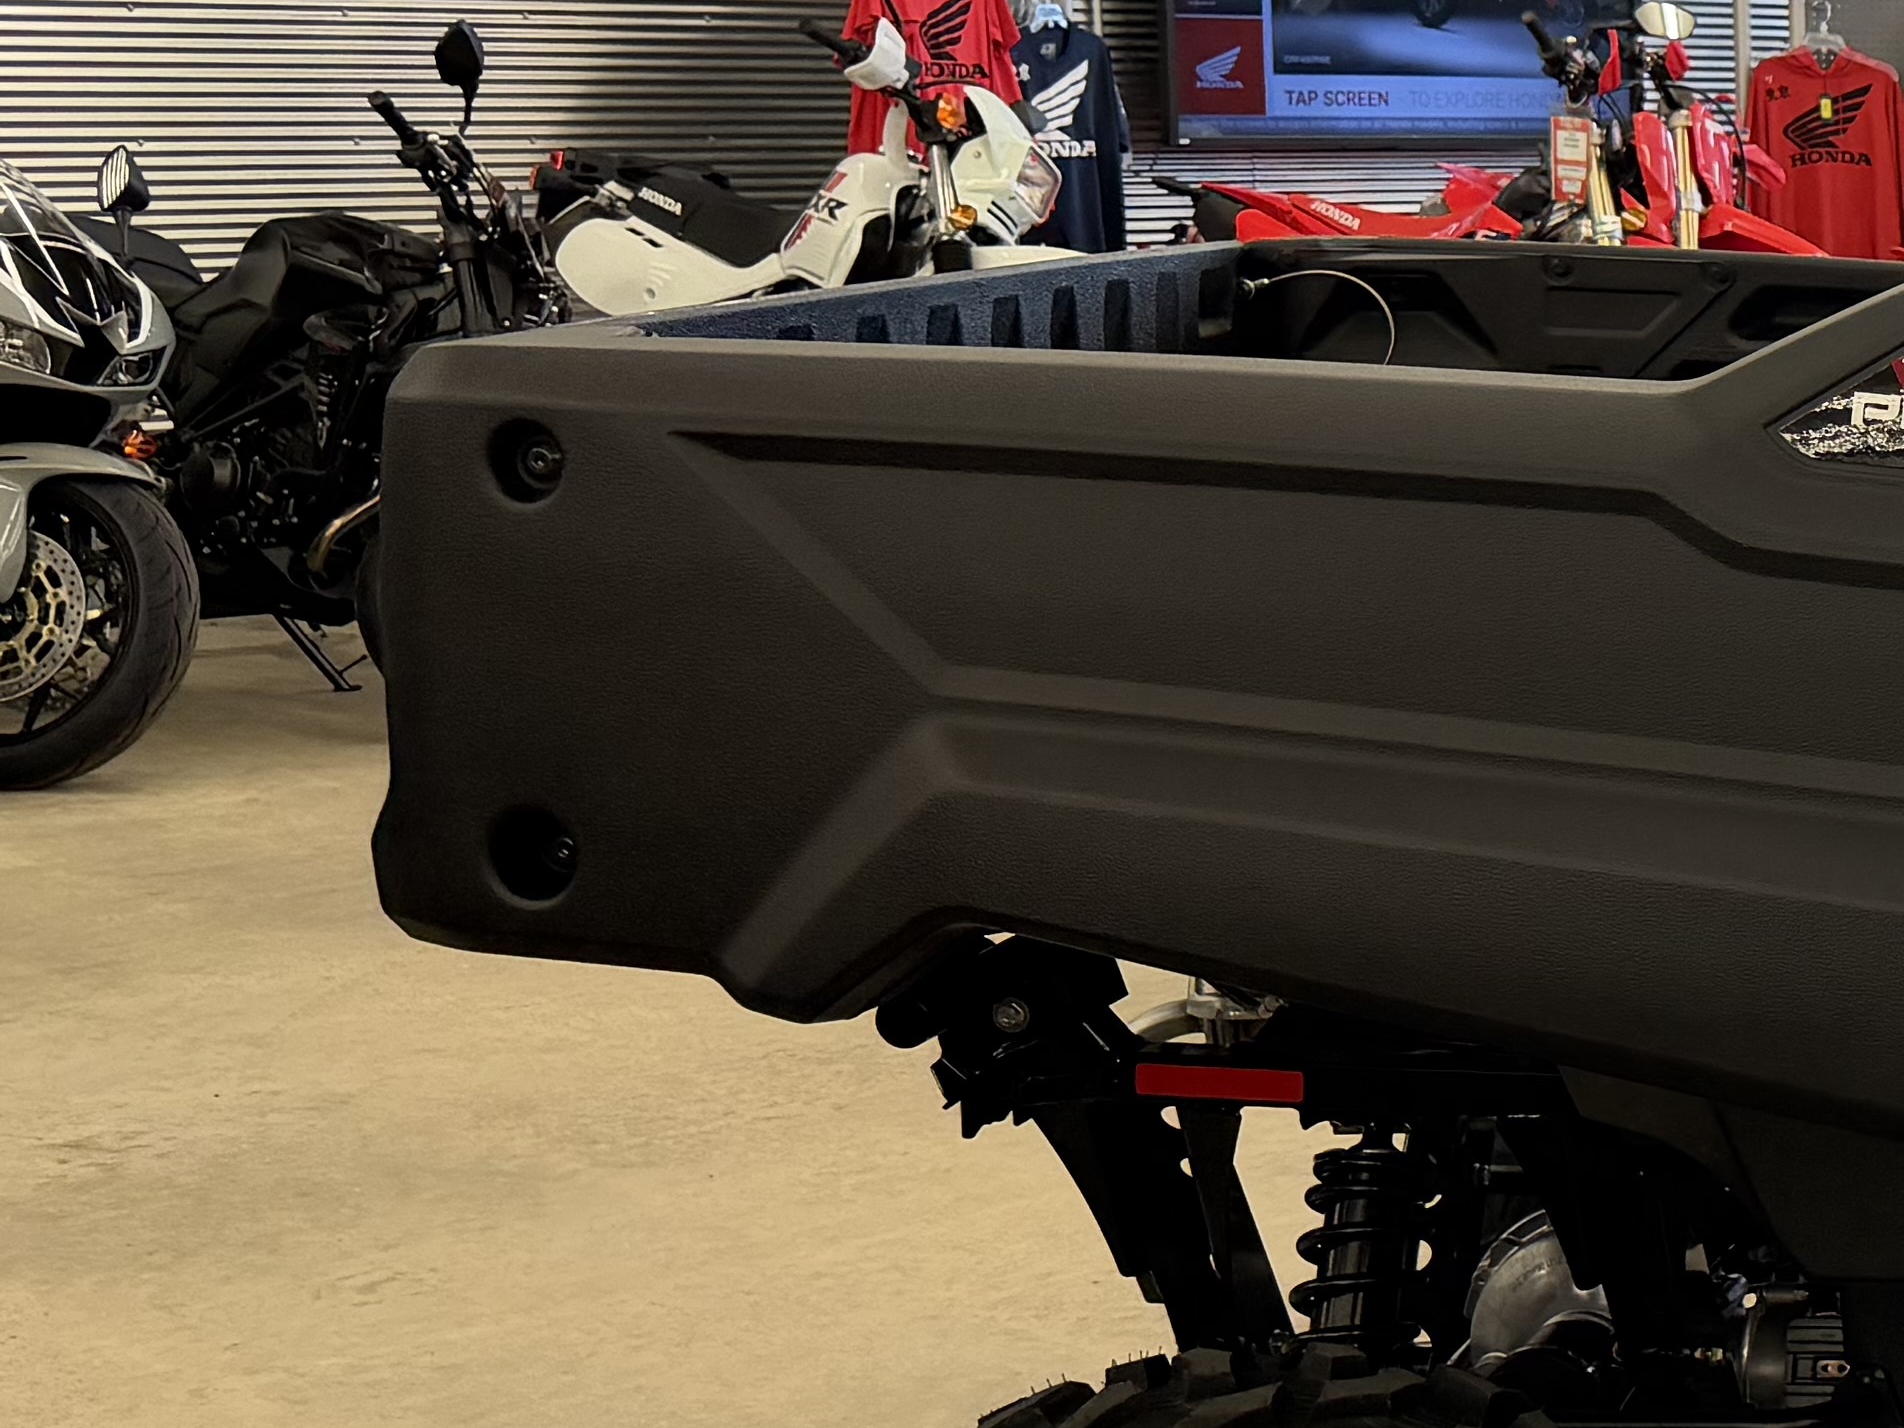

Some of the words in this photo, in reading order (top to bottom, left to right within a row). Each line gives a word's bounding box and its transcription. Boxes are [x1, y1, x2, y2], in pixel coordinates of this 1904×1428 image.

[1285, 90, 1319, 107] TAP
[1323, 91, 1389, 108] SCREEN
[1790, 150, 1873, 168] HONDA
[637, 186, 683, 217] HONDA
[1309, 200, 1361, 231] HONDA
